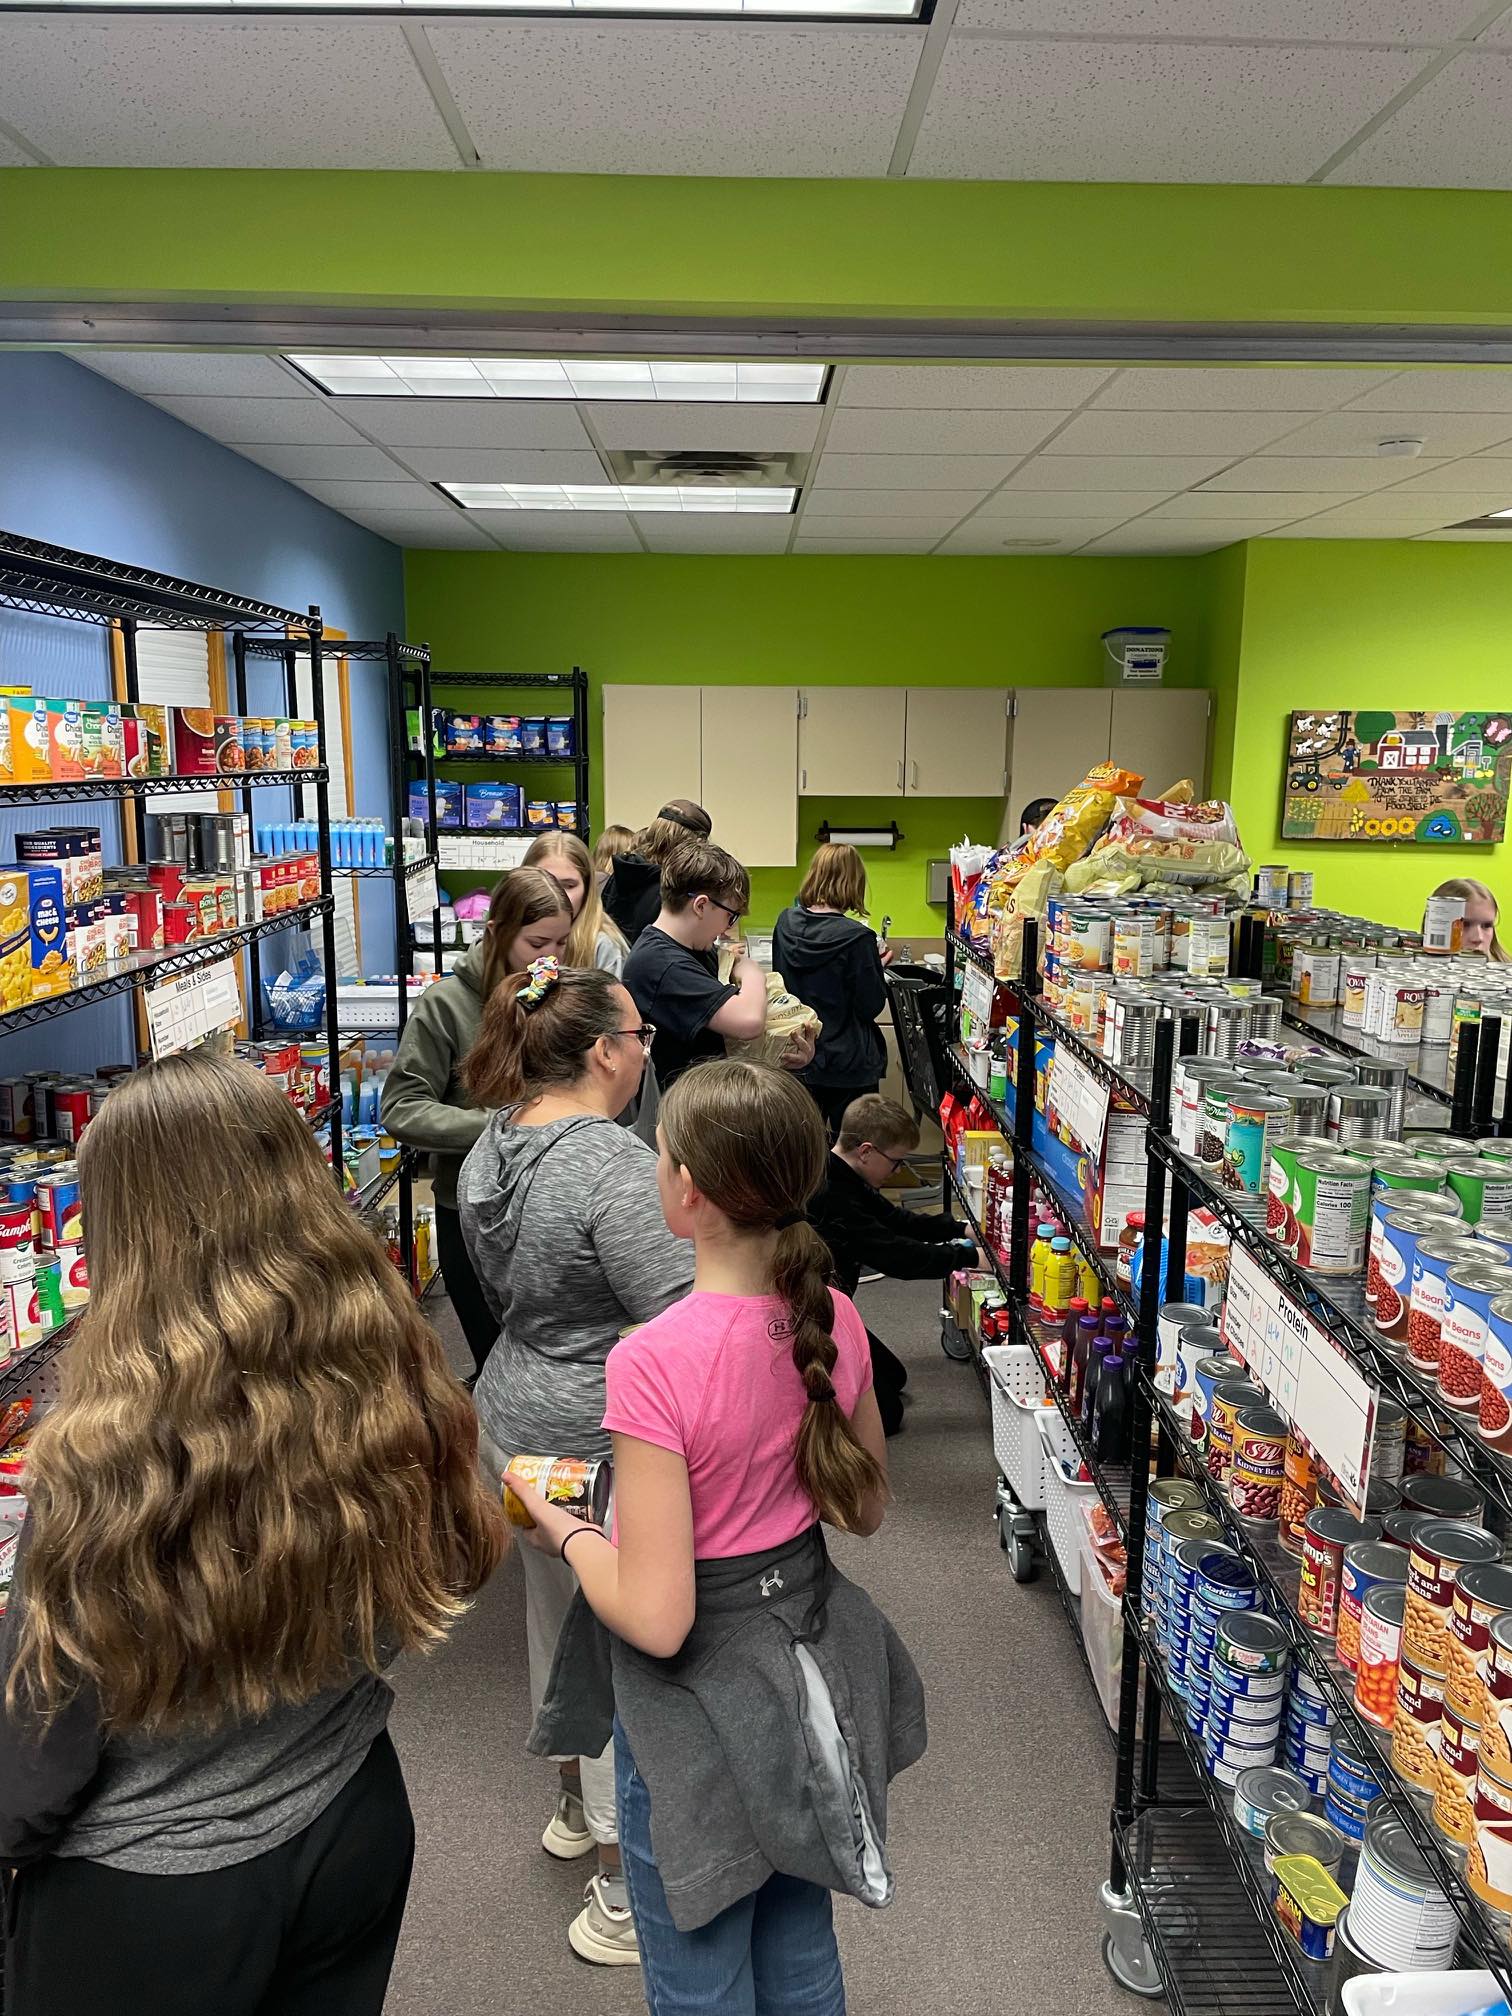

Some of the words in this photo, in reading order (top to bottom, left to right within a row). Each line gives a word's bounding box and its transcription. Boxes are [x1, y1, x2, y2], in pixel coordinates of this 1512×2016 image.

[1367, 777, 1397, 787] THANK
[1385, 802, 1405, 811] FOOD
[175, 978, 192, 993] Meals
[197, 970, 212, 984] Sides
[1346, 977, 1365, 987] OYA
[1318, 1179, 1339, 1187] Nutrition
[1340, 1180, 1353, 1188] Facts
[1316, 1200, 1338, 1208] Calories
[1421, 1290, 1444, 1306] Bean
[1278, 1295, 1309, 1342] Protein
[1451, 1321, 1481, 1340] Beans
[1213, 1428, 1232, 1443] BEANS
[1236, 1457, 1264, 1474] KIDNEY
[1205, 1582, 1238, 1599] StarKist
[1421, 1579, 1441, 1594] and
[1456, 1621, 1472, 1637] and
[1404, 1692, 1421, 1710] and
[1446, 1745, 1463, 1762] and
[1277, 1883, 1303, 1923] SPAM
